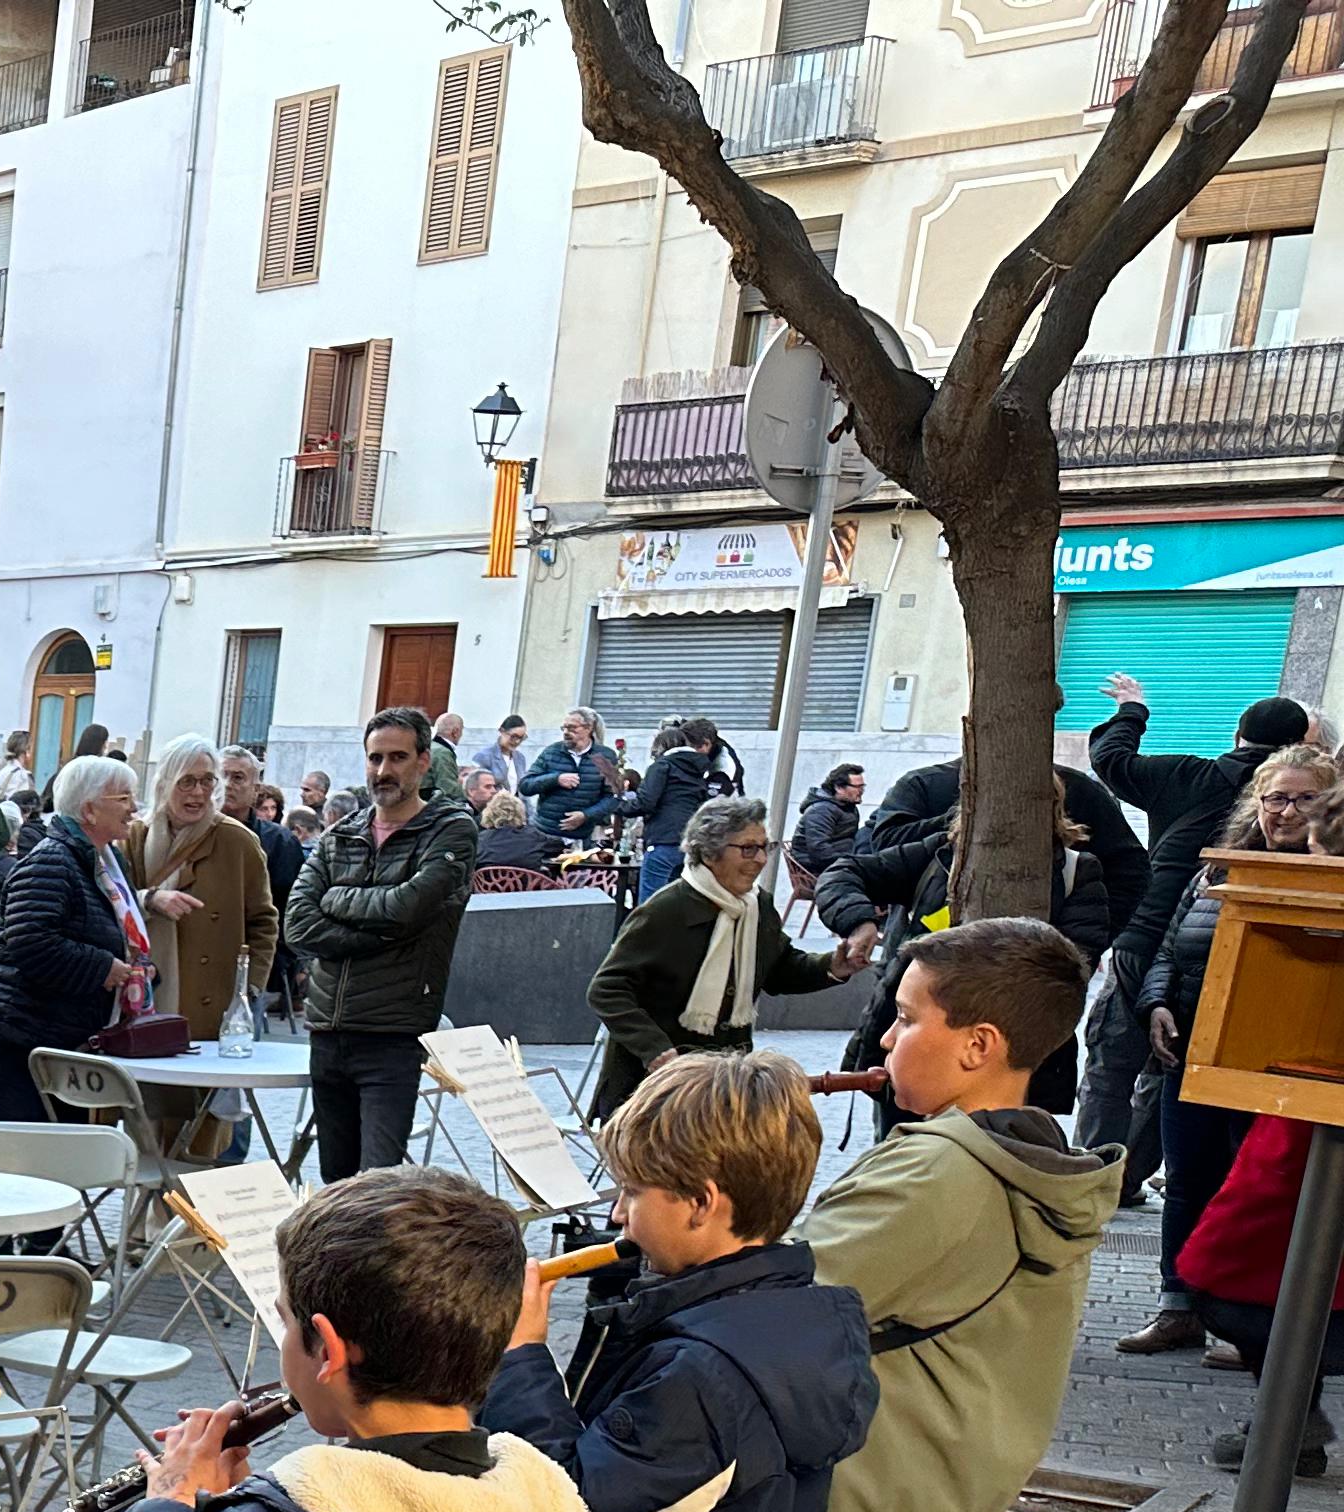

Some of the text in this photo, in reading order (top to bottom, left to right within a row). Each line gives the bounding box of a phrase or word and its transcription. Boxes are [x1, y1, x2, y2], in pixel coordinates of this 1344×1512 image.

[675, 571, 698, 582] CITY
[699, 567, 792, 581] SUPERMERCADOS
[1057, 575, 1087, 586] Olesa
